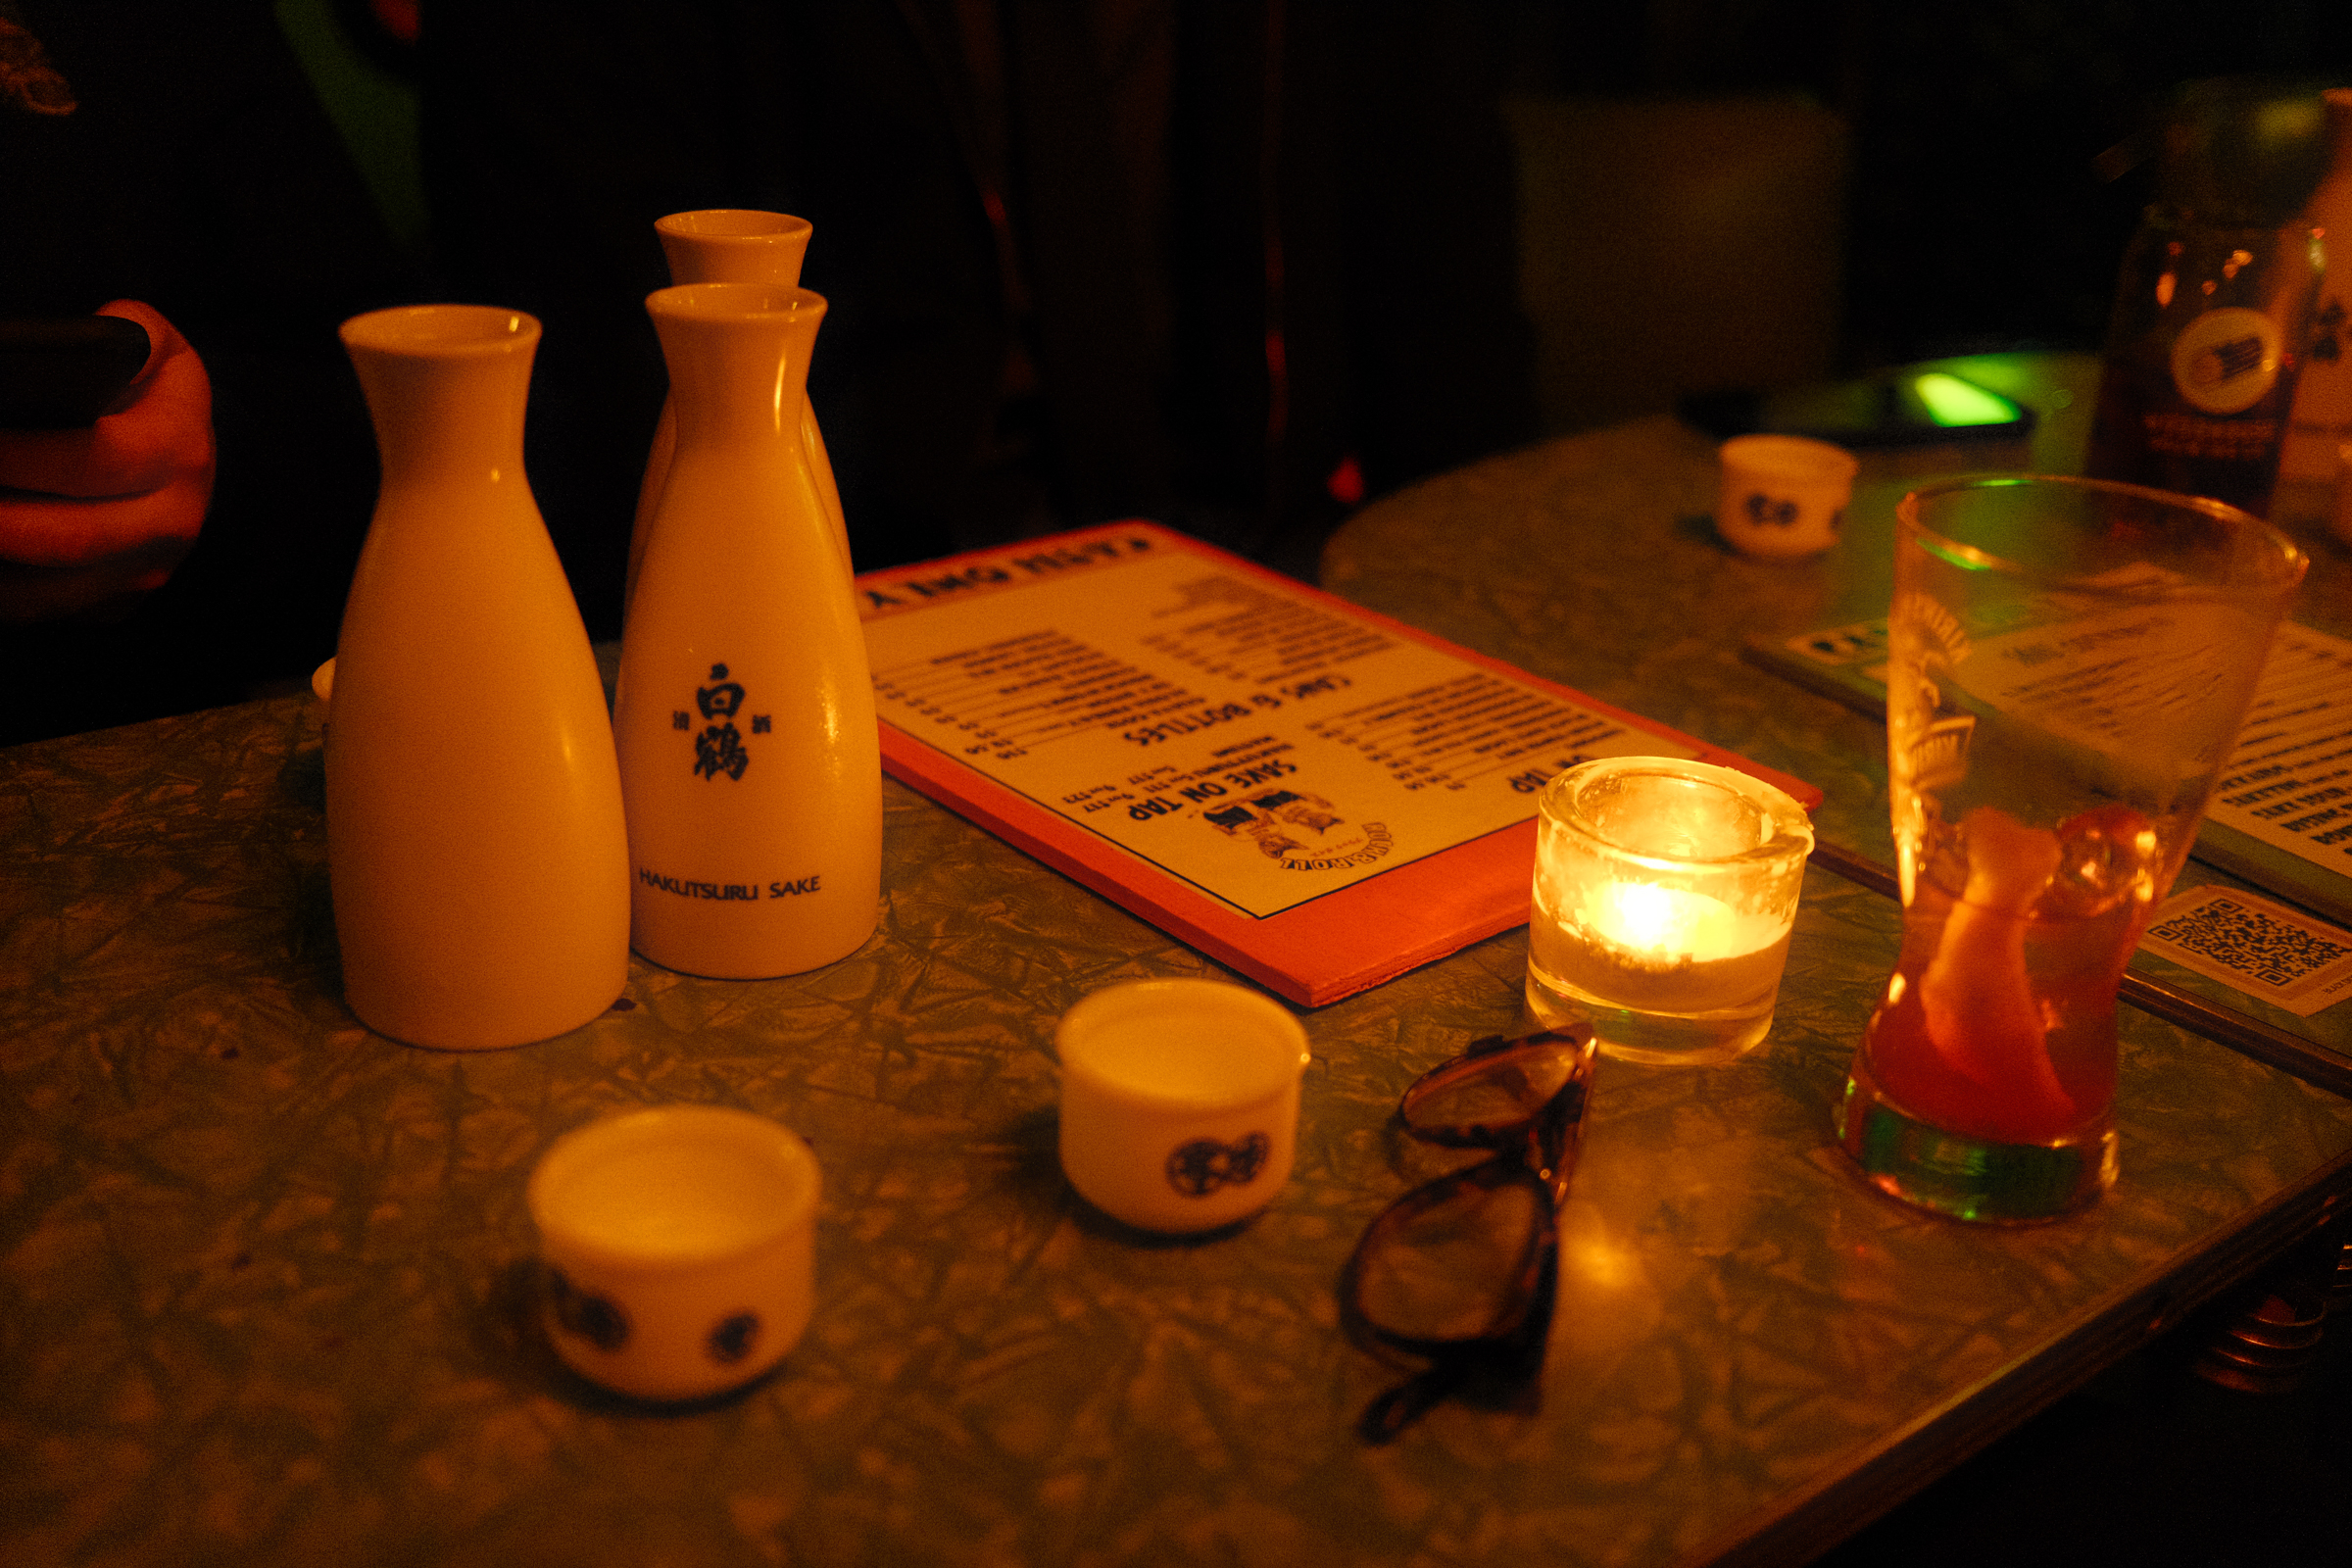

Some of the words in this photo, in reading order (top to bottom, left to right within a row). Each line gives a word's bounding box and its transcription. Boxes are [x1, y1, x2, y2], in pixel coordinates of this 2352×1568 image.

[694, 662, 750, 782] 白鶴
[1122, 705, 1254, 747] BOTTLES
[1224, 759, 1298, 791] SAKE
[1125, 794, 1184, 821] TAP
[1179, 780, 1228, 805] ON
[640, 866, 760, 902] HAKUTSURU
[769, 875, 822, 899] SAKE
